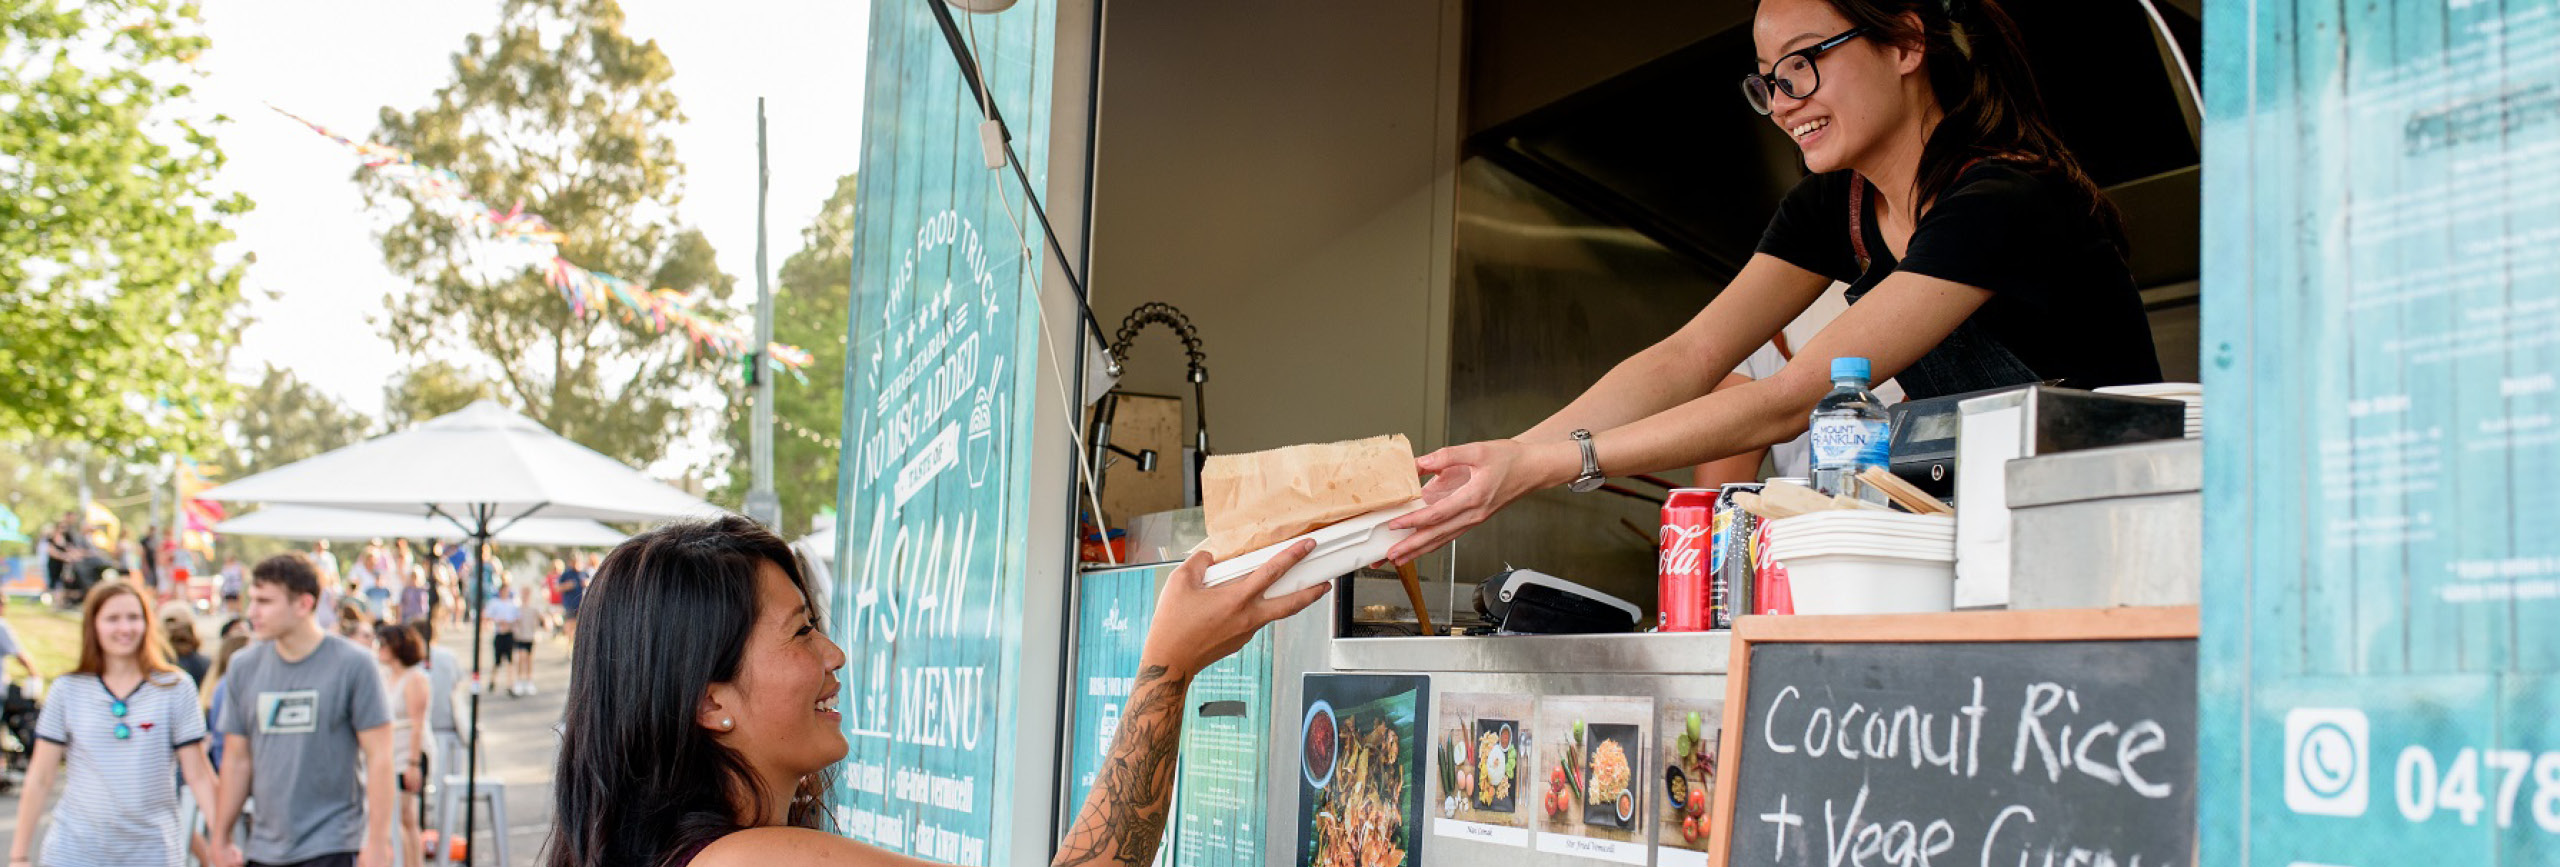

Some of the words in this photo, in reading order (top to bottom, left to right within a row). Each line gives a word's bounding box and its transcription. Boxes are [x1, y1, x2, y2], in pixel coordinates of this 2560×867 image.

[884, 248, 912, 330] THIS
[918, 210, 957, 262] FOOD
[962, 217, 999, 336] TRUCK
[889, 315, 955, 403] VEGETARIAN
[863, 428, 885, 490] NO
[886, 391, 919, 468] MSG
[922, 330, 979, 433] ADDED
[1813, 433, 1867, 447] FRANKLIN
[1820, 425, 1856, 433] MOUNT
[908, 453, 931, 488] TASTE
[933, 441, 943, 465] OF
[854, 492, 977, 643] ASIAN
[896, 666, 984, 752] MENU
[1765, 676, 1988, 778] Coconut
[2012, 681, 2172, 799] Rice
[931, 775, 974, 814] vermicelli
[1825, 785, 1955, 867] Vege
